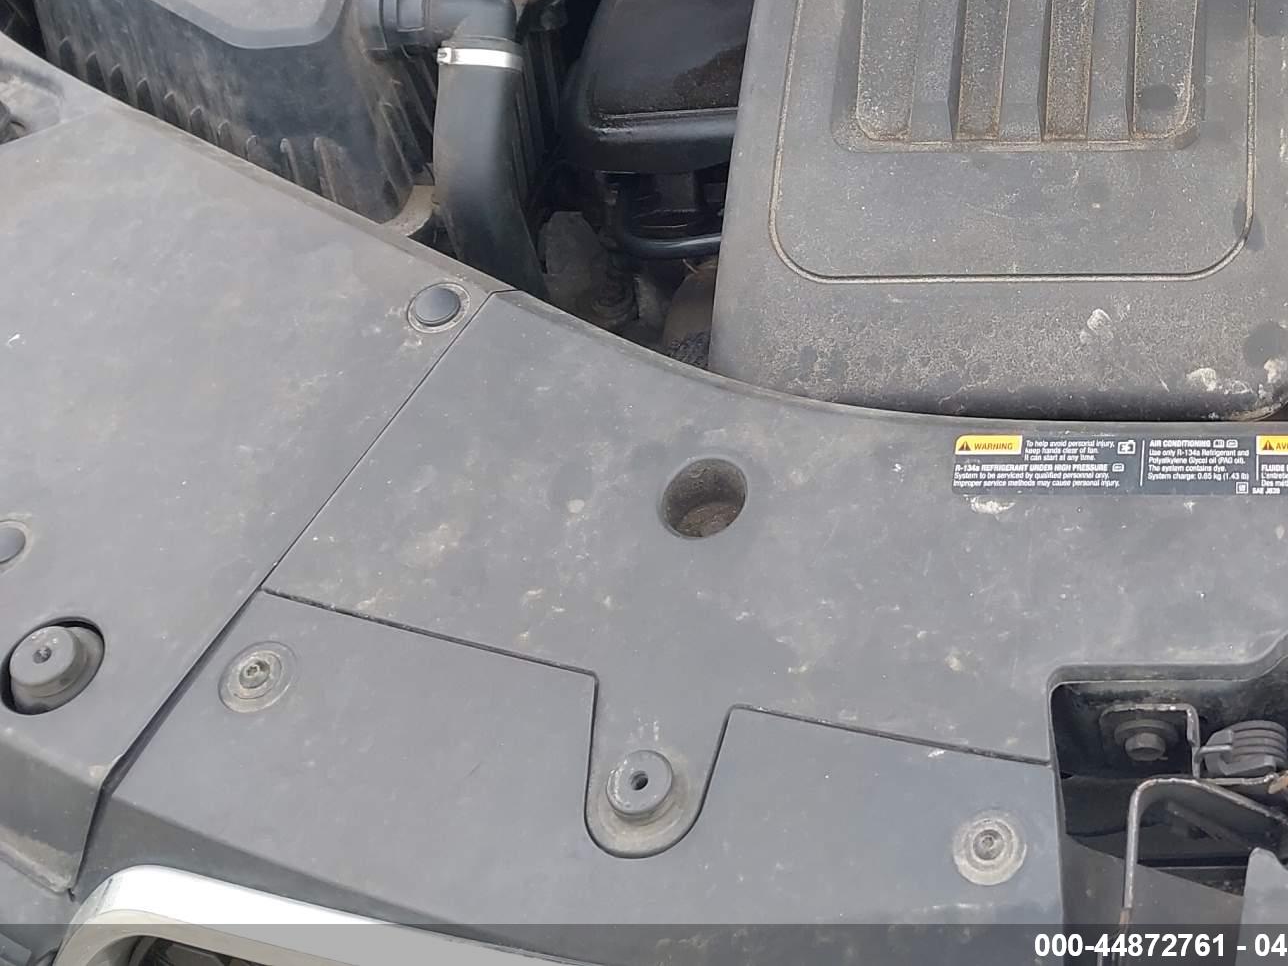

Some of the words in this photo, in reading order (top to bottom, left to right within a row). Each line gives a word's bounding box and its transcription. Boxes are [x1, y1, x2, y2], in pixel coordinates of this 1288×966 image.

[974, 442, 1013, 451] WARNING
[1035, 440, 1048, 448] help
[1068, 440, 1095, 448] personal
[1149, 439, 1161, 448] AIR
[1162, 439, 1211, 448] CONDITIONING
[1149, 448, 1161, 456] Use
[1162, 448, 1175, 456] only
[1201, 448, 1236, 457] Refrigerant
[1188, 457, 1207, 465] Glycol
[955, 464, 980, 472] R-134a
[981, 464, 1029, 472] REFRIGERANT
[1029, 464, 1053, 472] UNDER
[1054, 464, 1071, 472] HIGH
[1072, 464, 1108, 472] PRESSURE
[1261, 464, 1285, 472] FLUIDE
[954, 472, 978, 480] System
[1025, 472, 1033, 480] by
[1035, 472, 1062, 480] qualified
[1063, 472, 1095, 480] personnel
[1148, 472, 1171, 480] System
[1213, 472, 1221, 480] kg
[1036, 480, 1051, 488] may
[1261, 479, 1273, 487] Des
